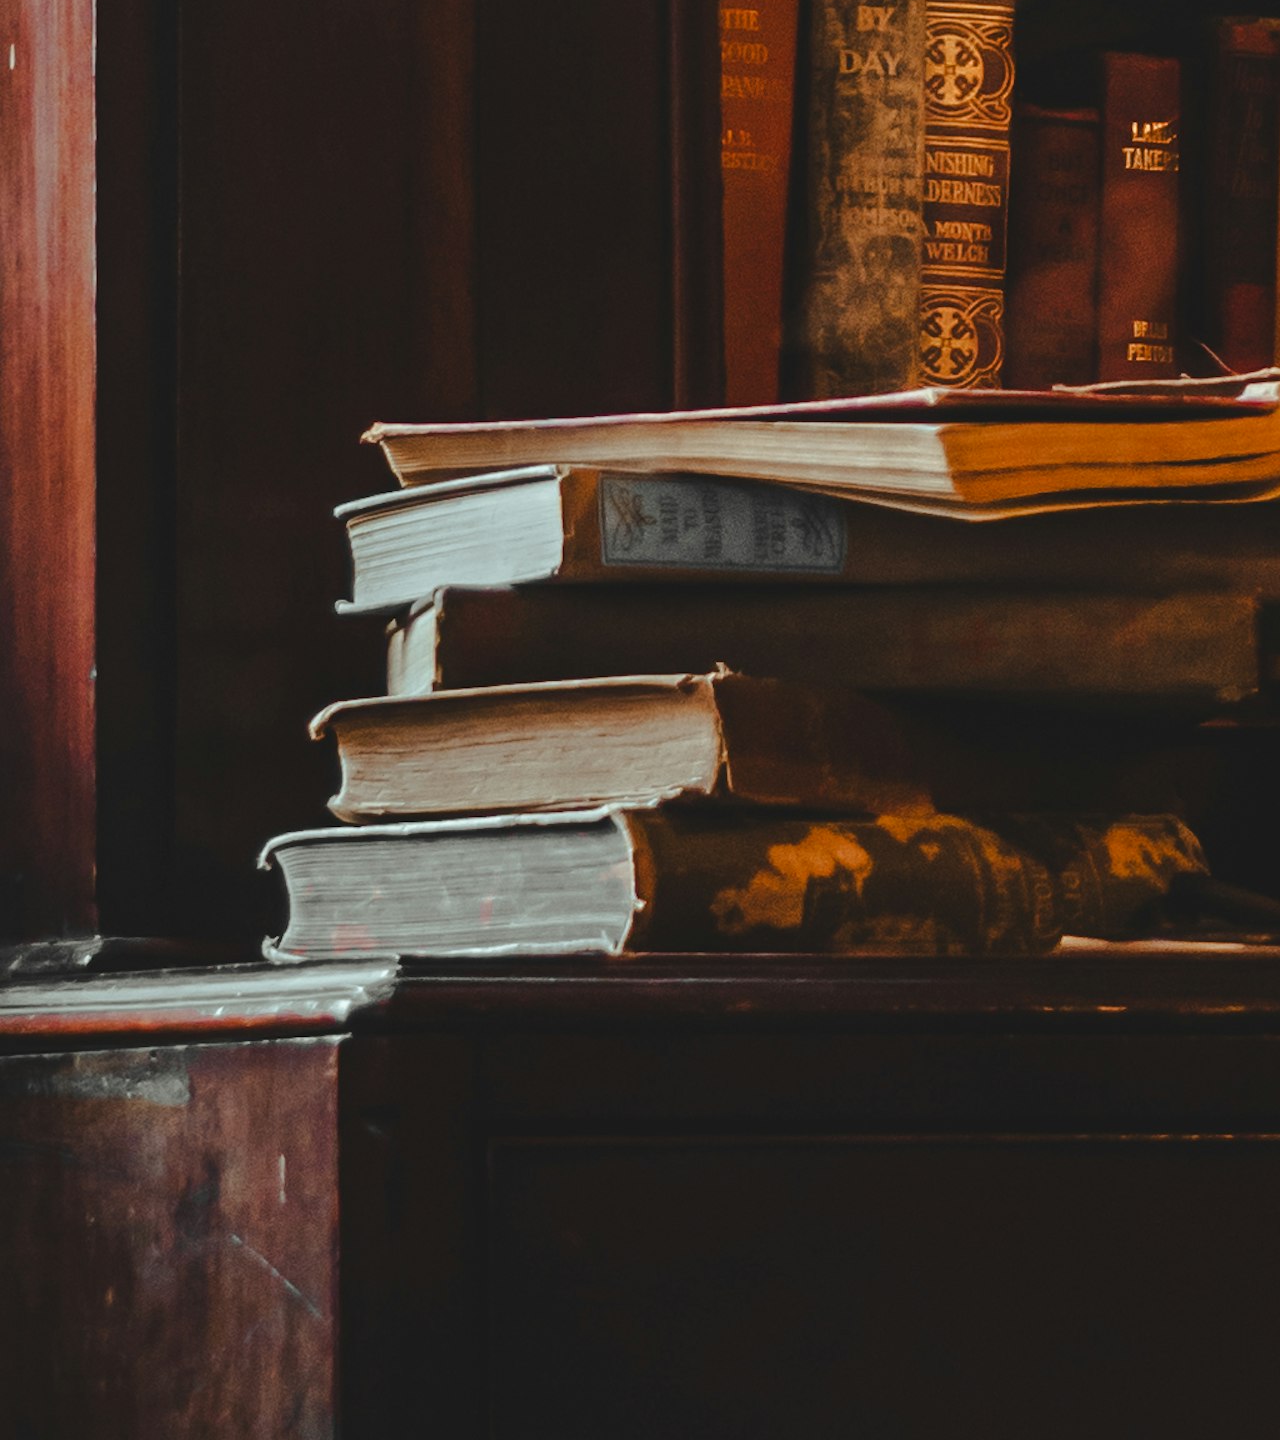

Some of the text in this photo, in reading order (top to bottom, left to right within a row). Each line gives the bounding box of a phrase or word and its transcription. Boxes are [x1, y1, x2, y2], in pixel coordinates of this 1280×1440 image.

[721, 7, 761, 32] THE
[856, 4, 896, 33] BY
[838, 49, 903, 77] DAY
[925, 151, 995, 178] NISHING
[925, 242, 989, 264] WELCH
